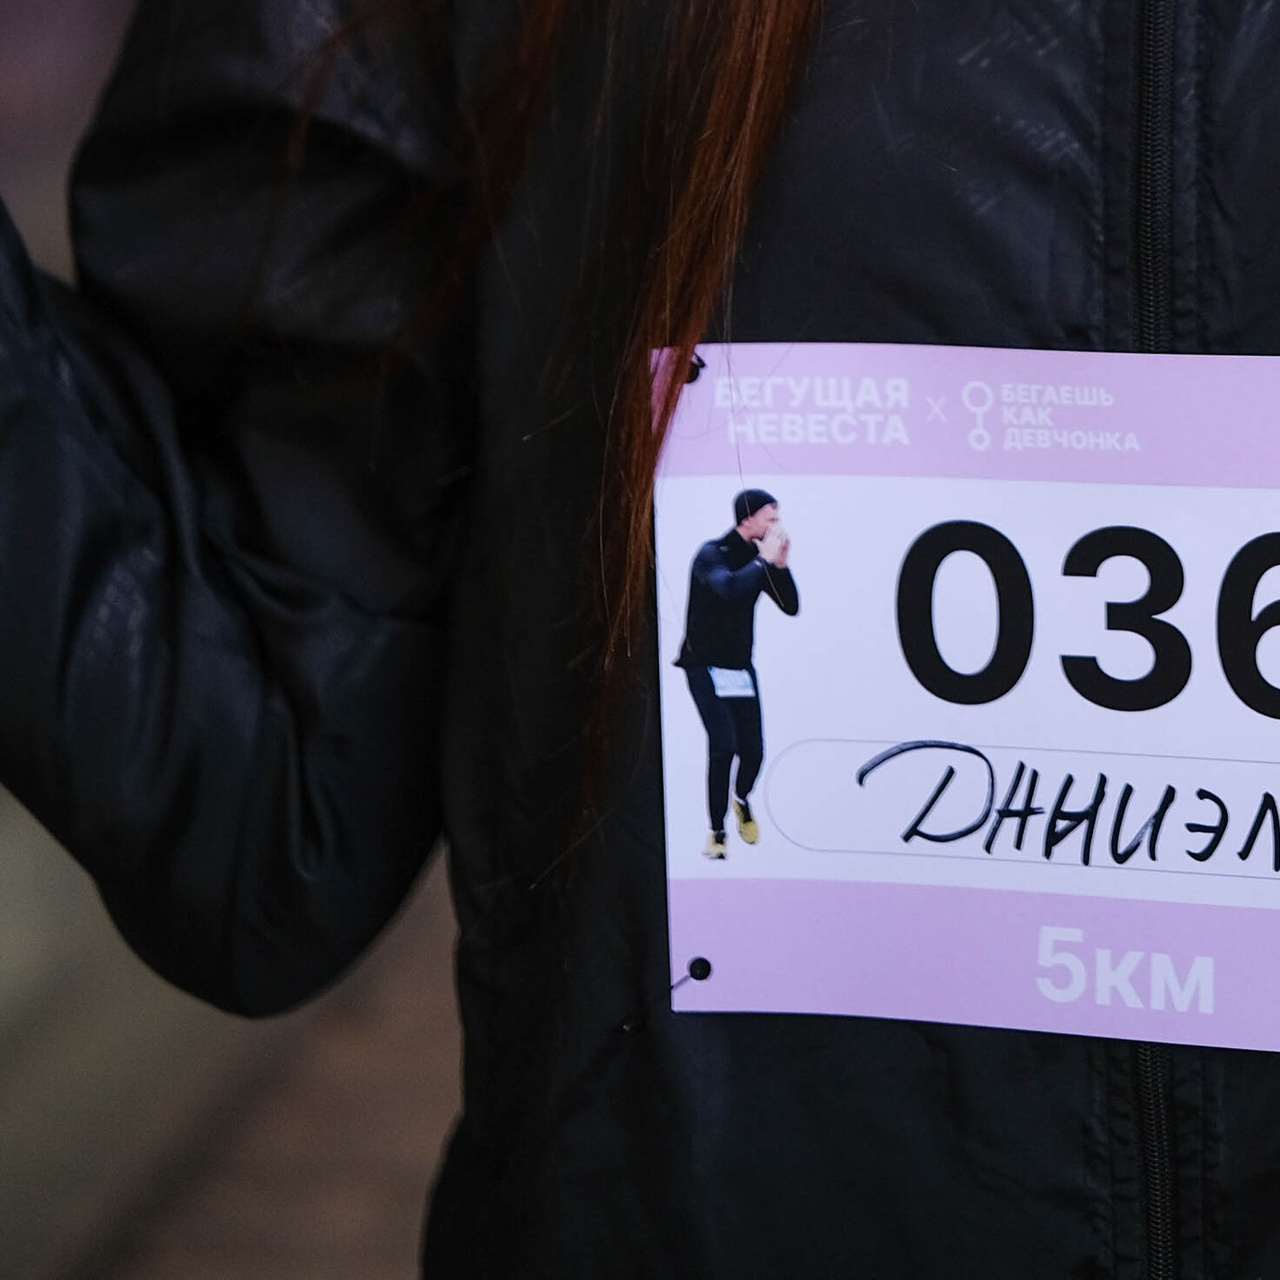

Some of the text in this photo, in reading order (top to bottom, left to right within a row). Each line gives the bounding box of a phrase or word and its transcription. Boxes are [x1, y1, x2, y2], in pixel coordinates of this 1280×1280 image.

[714, 376, 910, 412] БЕГУЩАЯ
[1001, 384, 1115, 406] БЕГАЕШЬ
[1002, 406, 1054, 426] КАК
[728, 412, 911, 445] НЕВЕСТА
[1002, 427, 1141, 451] ДЕВЧОНКА
